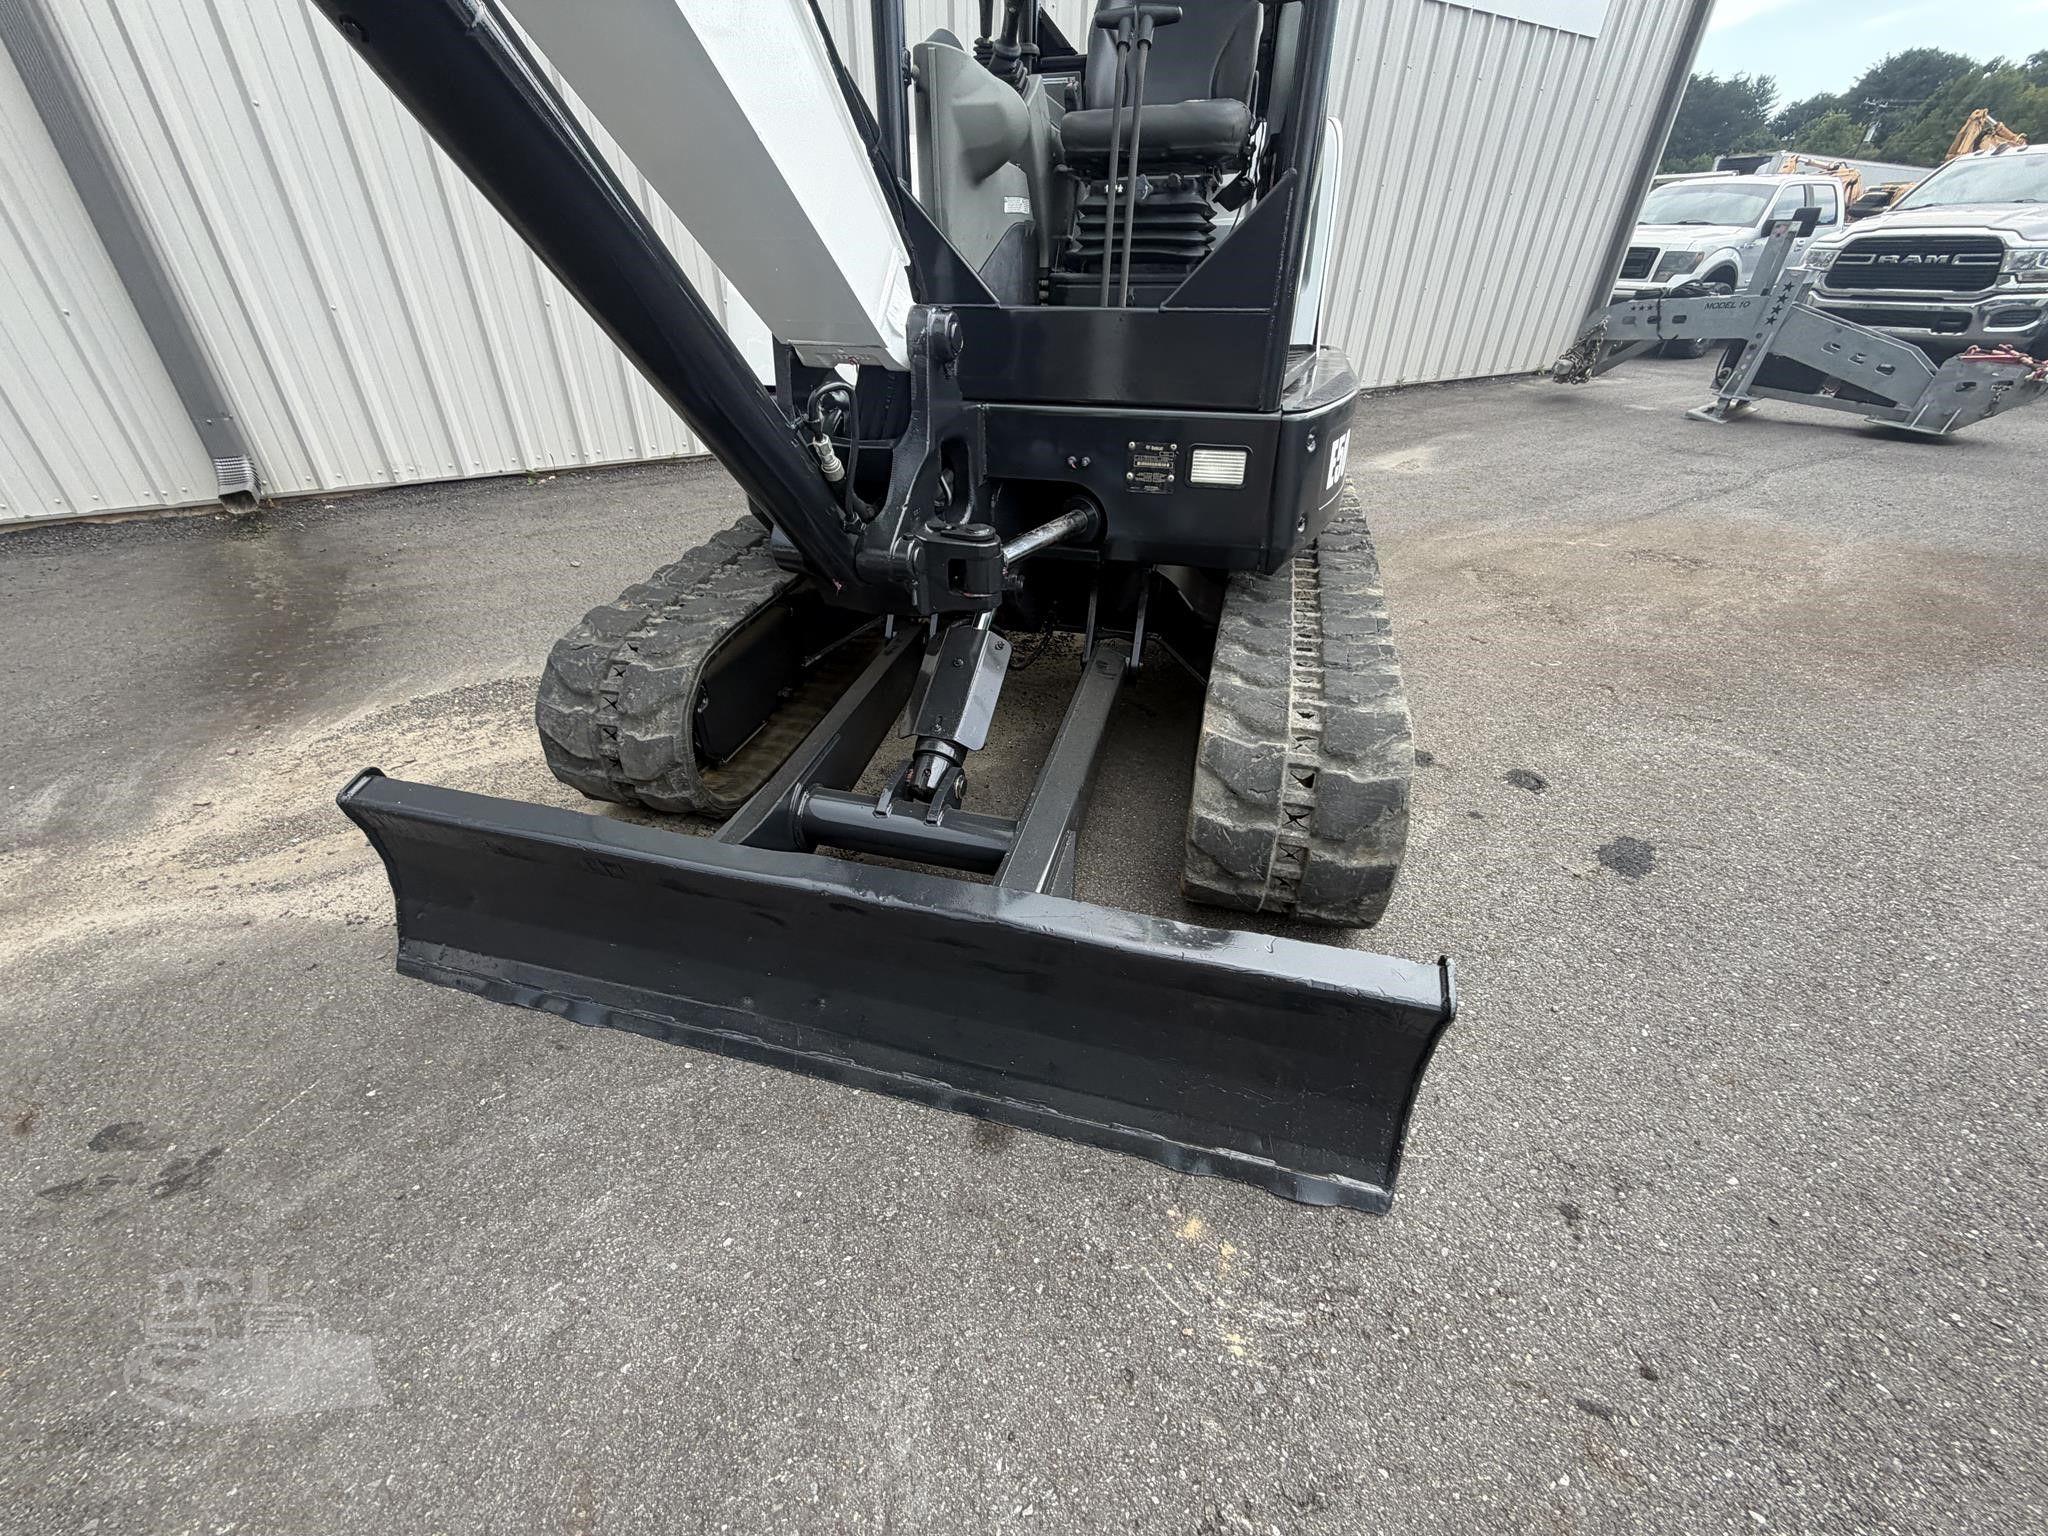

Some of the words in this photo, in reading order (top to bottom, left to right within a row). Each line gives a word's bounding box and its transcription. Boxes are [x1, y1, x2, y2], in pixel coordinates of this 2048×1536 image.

[1877, 254, 1950, 264] RAM
[1704, 301, 1736, 310] MODEL
[1738, 300, 1751, 309] 10
